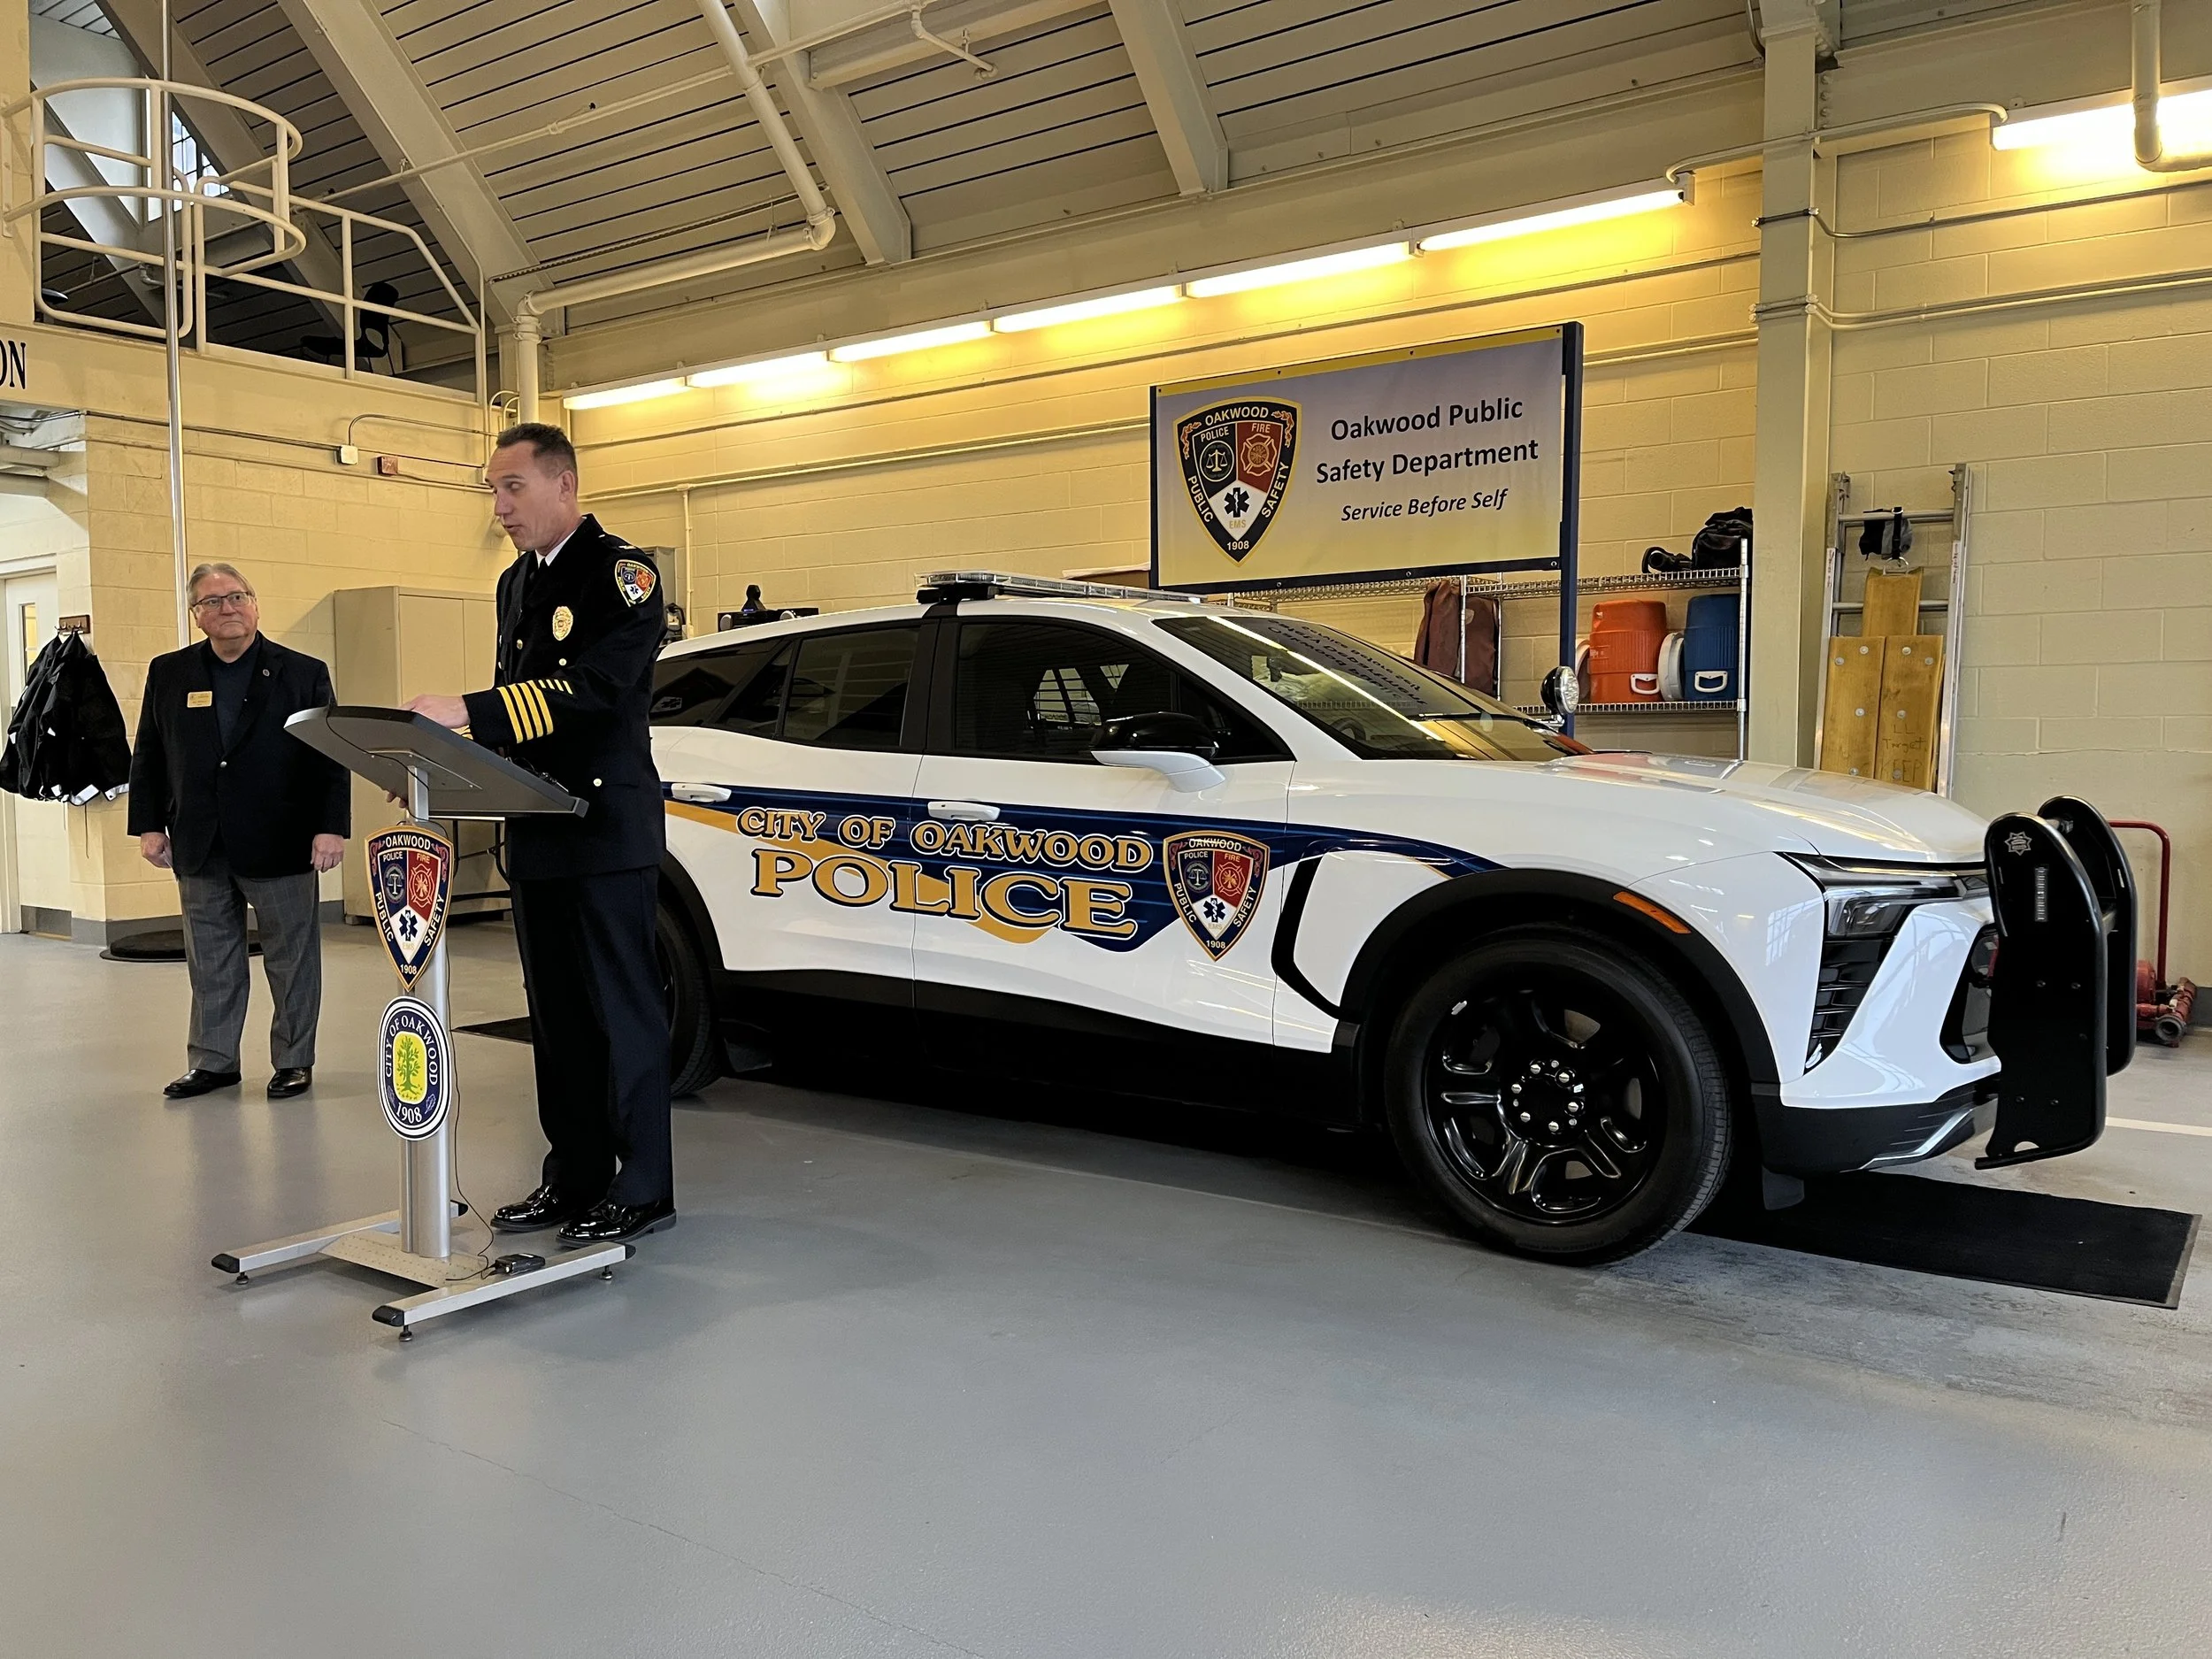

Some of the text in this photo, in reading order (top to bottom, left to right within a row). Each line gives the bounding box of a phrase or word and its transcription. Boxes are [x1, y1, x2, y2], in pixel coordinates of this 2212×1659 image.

[1205, 406, 1269, 426] OAKWOOD
[1331, 397, 1523, 441] Oakwood Public
[1200, 426, 1230, 442] POLICE
[1251, 423, 1271, 434] FIRE
[1317, 440, 1539, 484] Safety Department
[1187, 475, 1214, 523] PUBLIC
[1261, 461, 1290, 518] SAFETY
[1341, 488, 1509, 522] Service Before Self
[1228, 518, 1247, 529] EMS
[1226, 540, 1249, 551] 1908
[1882, 736, 1926, 753] Target
[385, 834, 431, 850] OAKWOOD
[737, 806, 1153, 872] CITY OF OAKWOOD
[1188, 838, 1242, 852] OAKWOOD
[382, 850, 403, 863] POLICE
[416, 852, 431, 864] FIRE
[1184, 850, 1209, 859] POLICE
[1224, 853, 1240, 863] FIRE
[750, 848, 1137, 940] POLICE
[1173, 882, 1197, 923] PUBLIC
[1233, 886, 1256, 927] SAFETY
[375, 893, 395, 942] PUBLIC
[423, 895, 445, 947] SAFETY
[1206, 940, 1226, 949] 1908
[399, 964, 418, 975] 1908
[385, 1015, 439, 1086] CITY OF OAKWOOD
[396, 1102, 423, 1125] 1908
